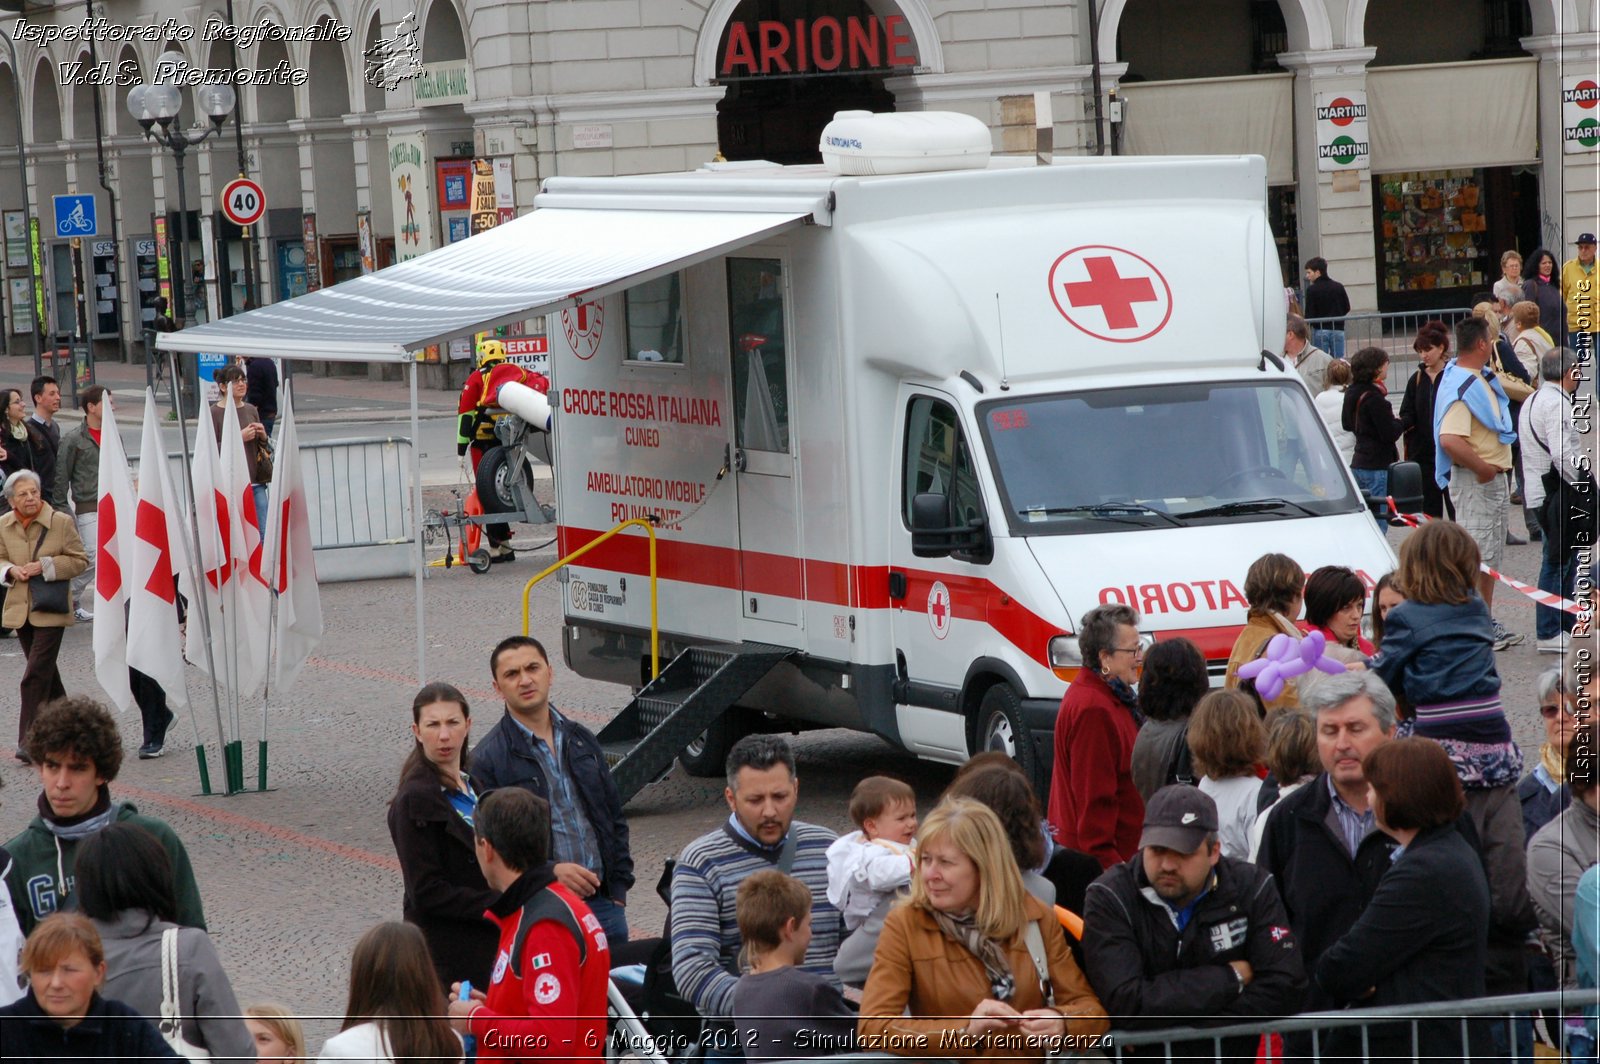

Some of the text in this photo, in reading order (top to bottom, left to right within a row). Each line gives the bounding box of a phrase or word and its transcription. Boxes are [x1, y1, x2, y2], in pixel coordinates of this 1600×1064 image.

[722, 15, 917, 75] ARIONE
[1318, 104, 1366, 119] MARTINI
[1320, 143, 1368, 157] MARTINI
[233, 192, 256, 211] 40
[563, 388, 721, 427] CROCE ROSSA ITALIANA
[625, 426, 660, 448] CUNEO
[587, 471, 706, 504] AMBULATORIO MOBILE
